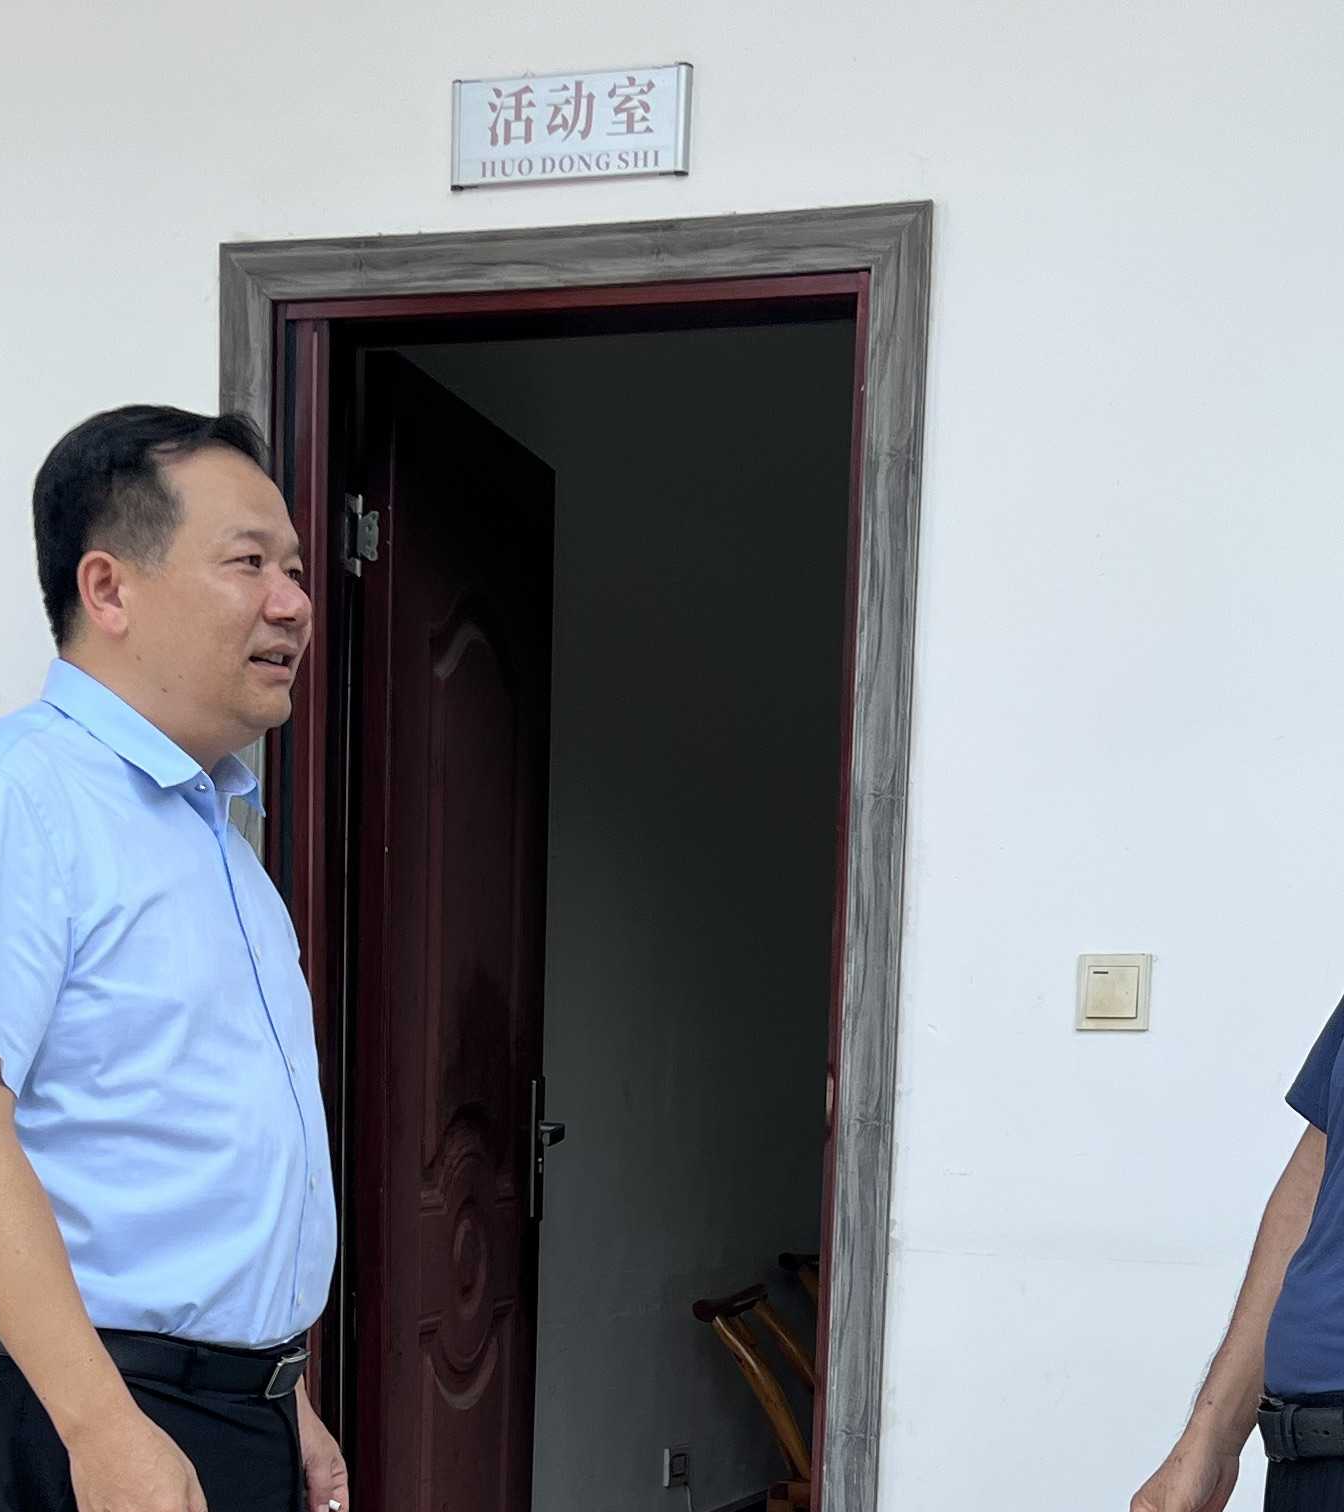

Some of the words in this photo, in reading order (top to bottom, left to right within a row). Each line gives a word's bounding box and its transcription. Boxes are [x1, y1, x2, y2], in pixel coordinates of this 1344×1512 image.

[488, 76, 656, 147] 活动室
[481, 159, 533, 178] HUO
[541, 153, 610, 174] DONG
[617, 150, 660, 169] SHI
